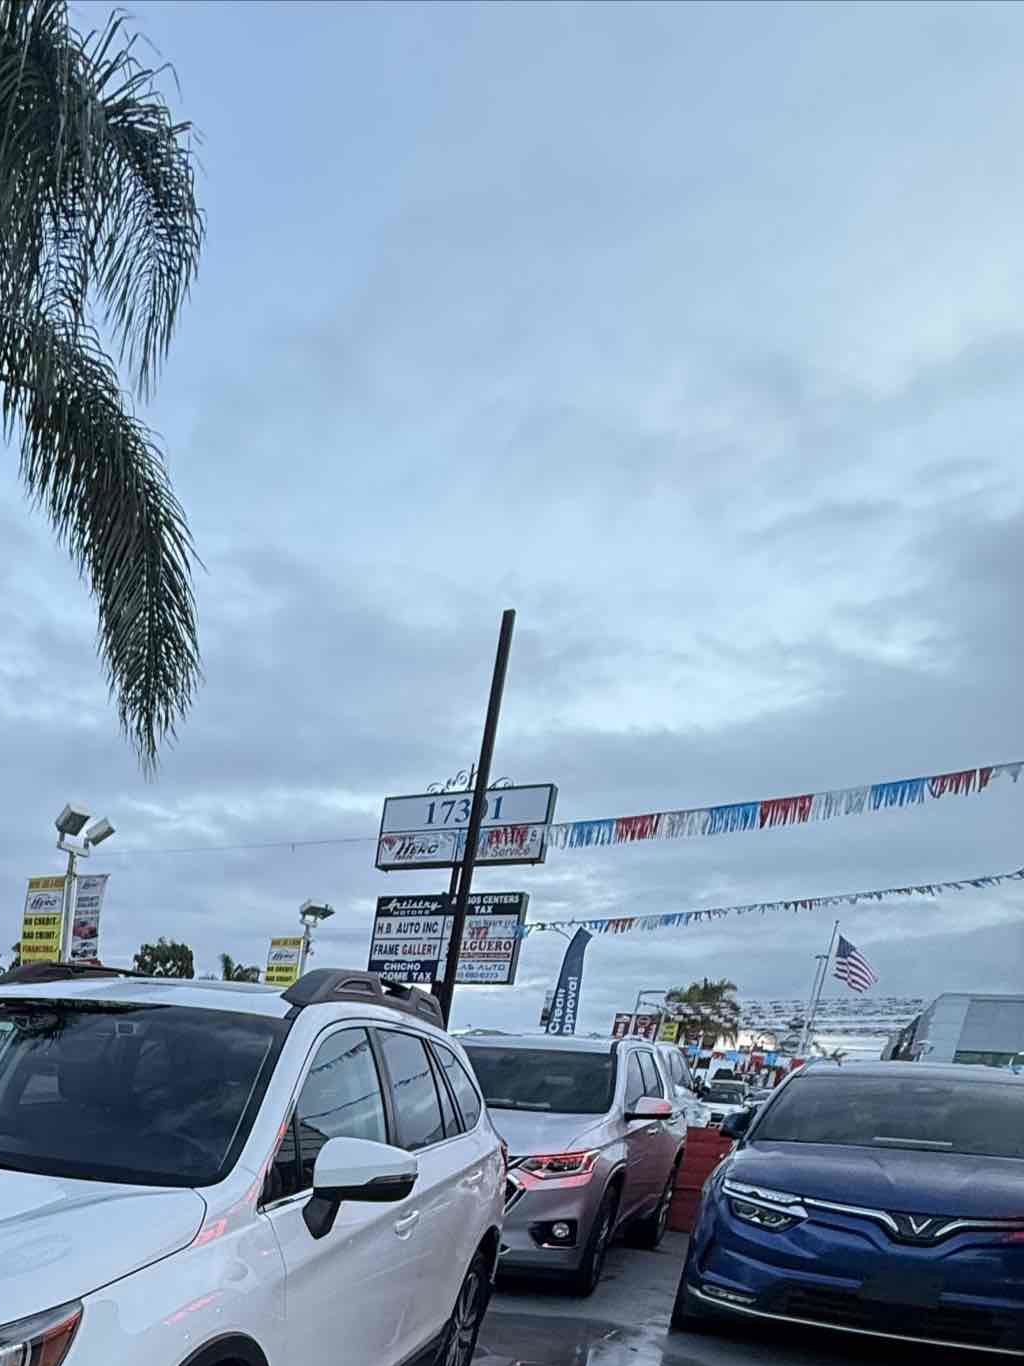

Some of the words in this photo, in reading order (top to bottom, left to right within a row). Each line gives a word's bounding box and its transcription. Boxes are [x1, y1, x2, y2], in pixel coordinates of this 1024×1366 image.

[490, 846, 530, 858] Service
[381, 898, 442, 912] Artistry
[483, 895, 520, 904] CENTERS
[474, 905, 494, 913] TAX
[396, 922, 421, 934] AUTO
[422, 921, 439, 934] INC
[373, 943, 400, 956] FRAME
[401, 943, 438, 956] GALLERY
[383, 962, 421, 971] CHICHO
[412, 971, 432, 983] TAX
[562, 976, 579, 1034] pproval
